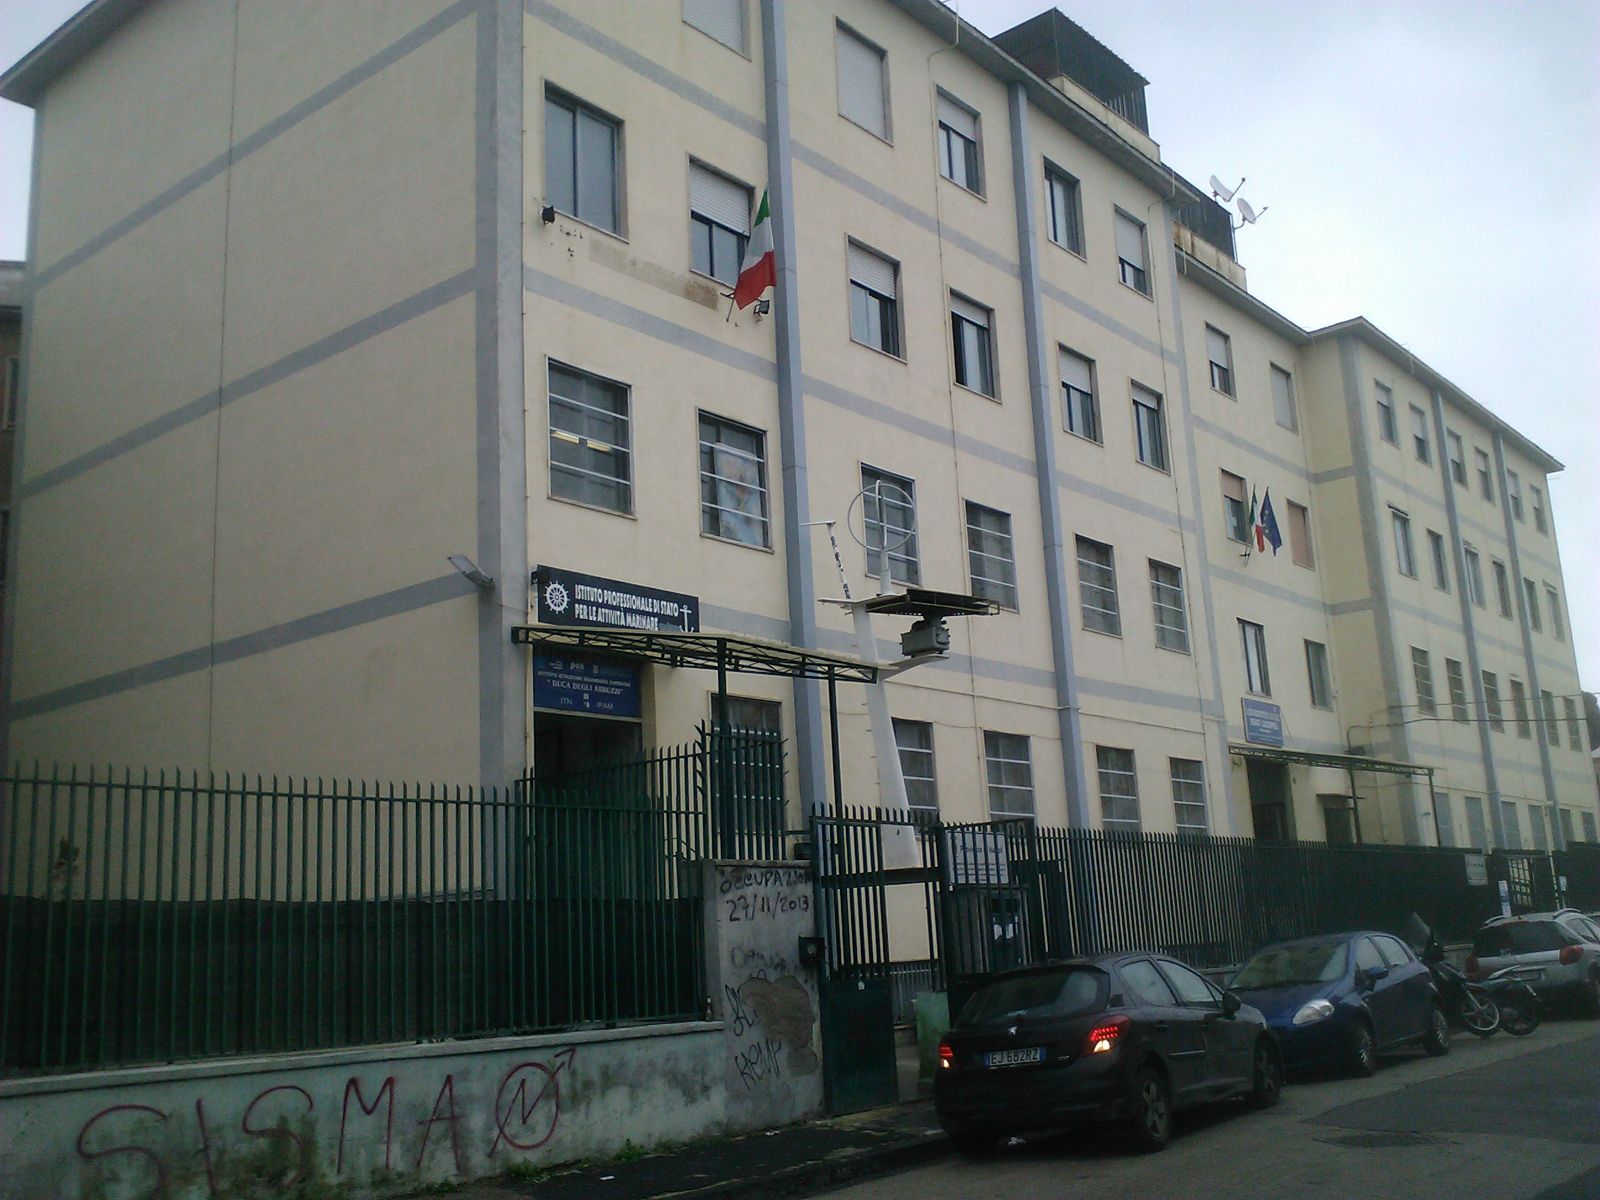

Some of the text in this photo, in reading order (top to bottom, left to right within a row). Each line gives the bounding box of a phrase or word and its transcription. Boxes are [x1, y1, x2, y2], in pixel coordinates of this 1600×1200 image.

[574, 584, 679, 617] ISTITUTO PROFESSIONALE DI STATO
[574, 604, 588, 619] PER
[588, 606, 597, 621] LE
[626, 612, 659, 631] MARINARE
[572, 681, 592, 691] DEGLI
